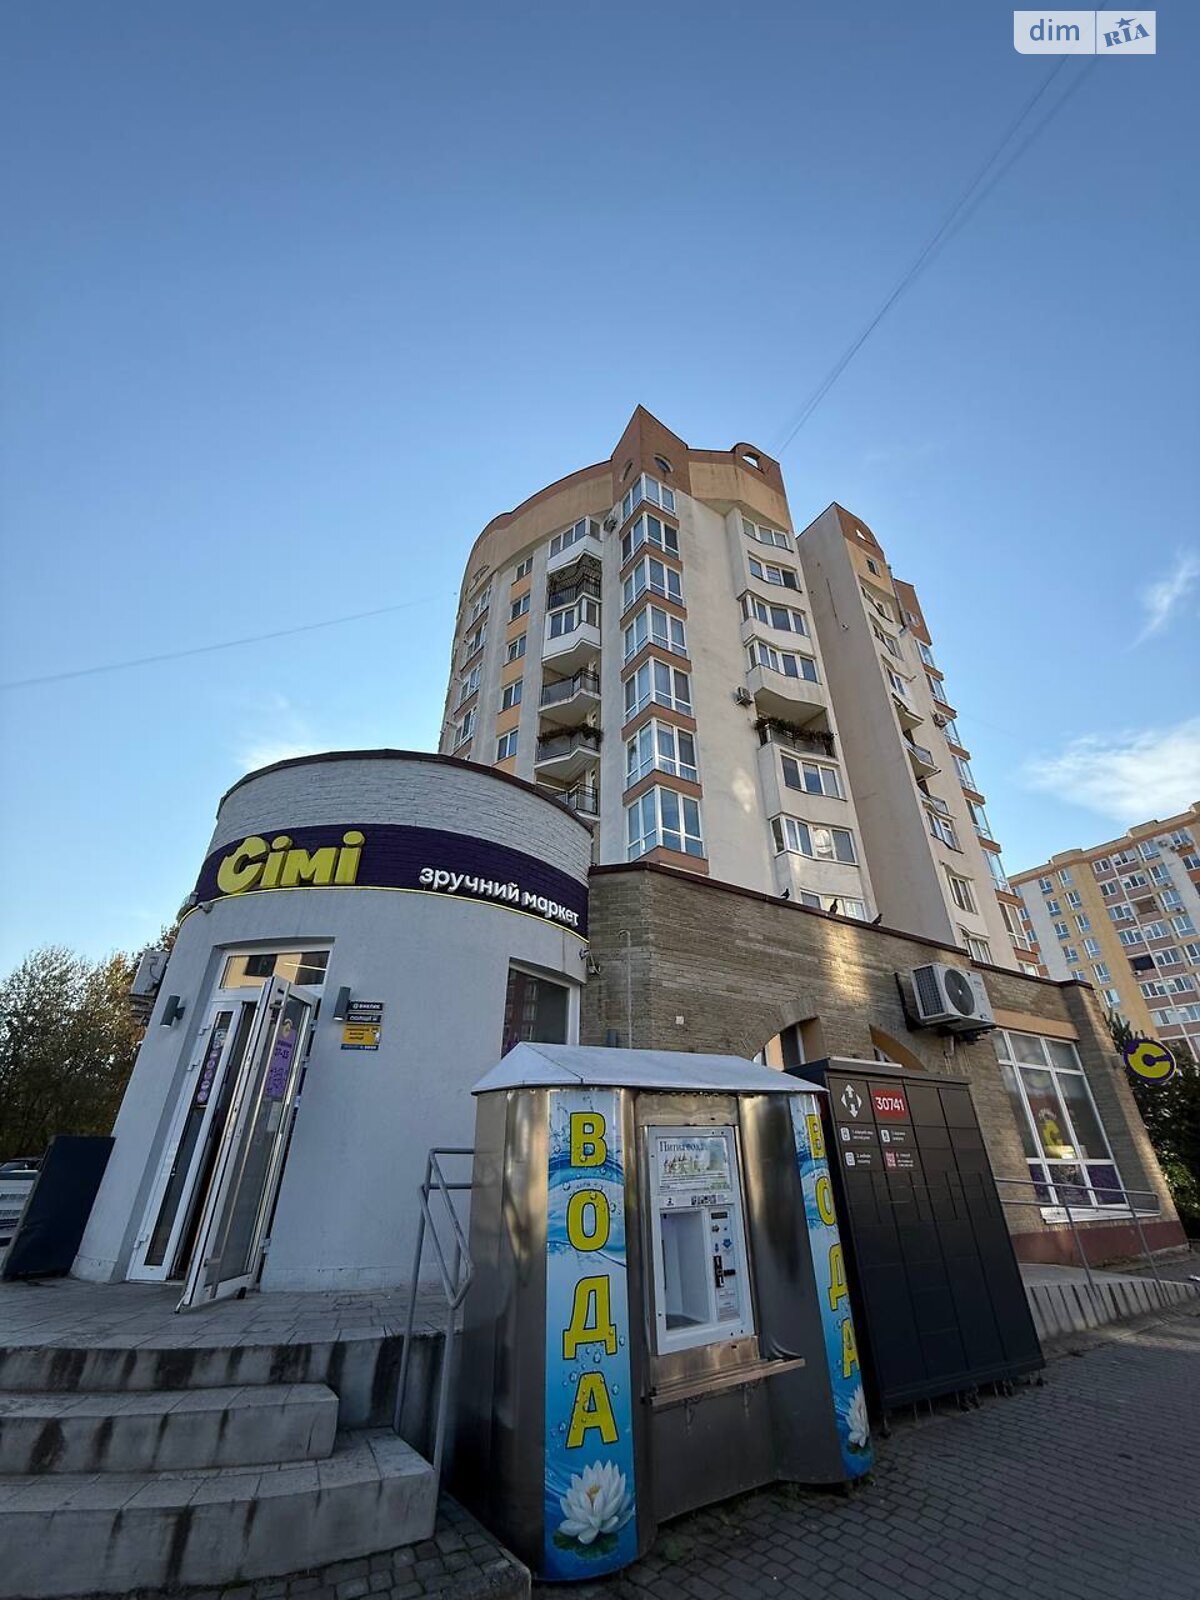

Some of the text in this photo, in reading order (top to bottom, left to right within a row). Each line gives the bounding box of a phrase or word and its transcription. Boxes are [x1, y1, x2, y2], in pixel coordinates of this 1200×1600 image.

[216, 830, 367, 895] Сімі
[419, 866, 580, 927] зручний маркет
[875, 1096, 905, 1111] 30741
[805, 1113, 860, 1379] ВОДА
[562, 1112, 619, 1449] ВОДА
